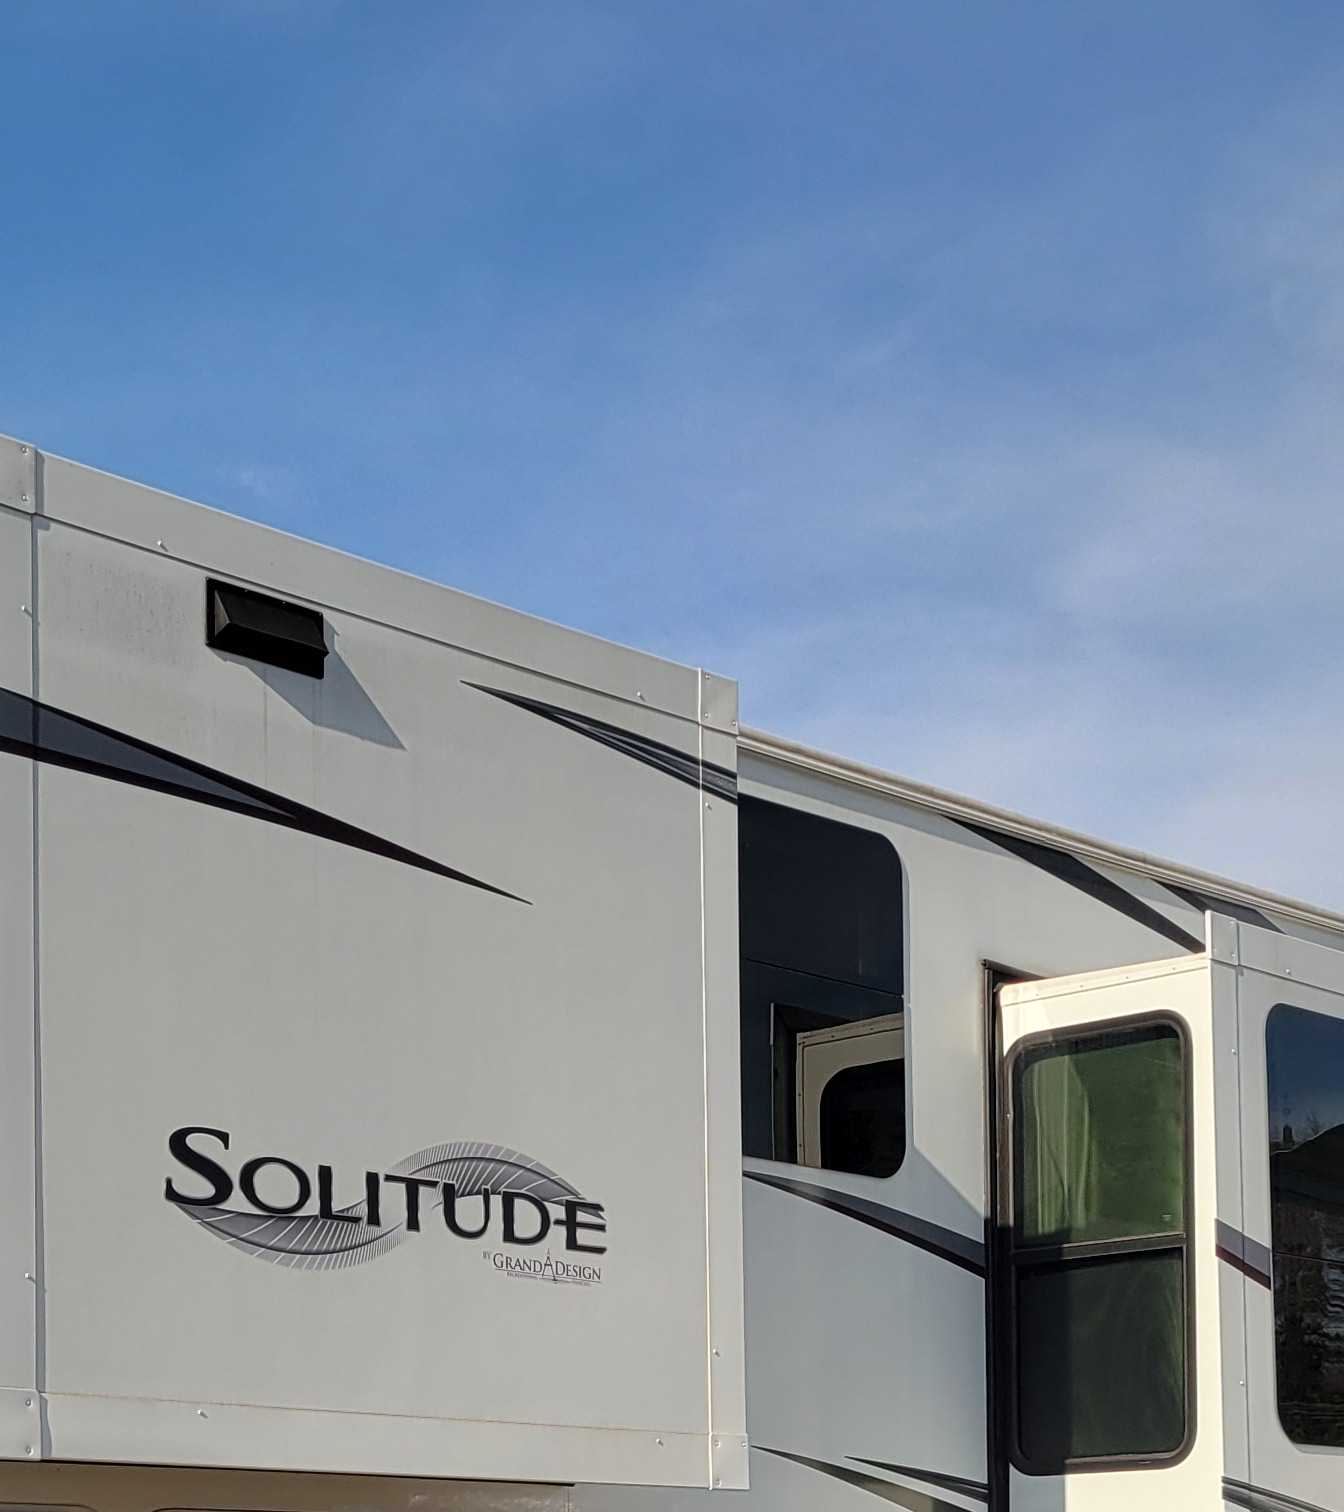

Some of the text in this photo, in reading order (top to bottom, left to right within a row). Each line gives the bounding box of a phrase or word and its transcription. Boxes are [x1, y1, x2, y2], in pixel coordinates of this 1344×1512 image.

[165, 1126, 607, 1255] SOLITUDE
[493, 1252, 543, 1274] GRAND
[555, 1260, 602, 1281] DESIGN
